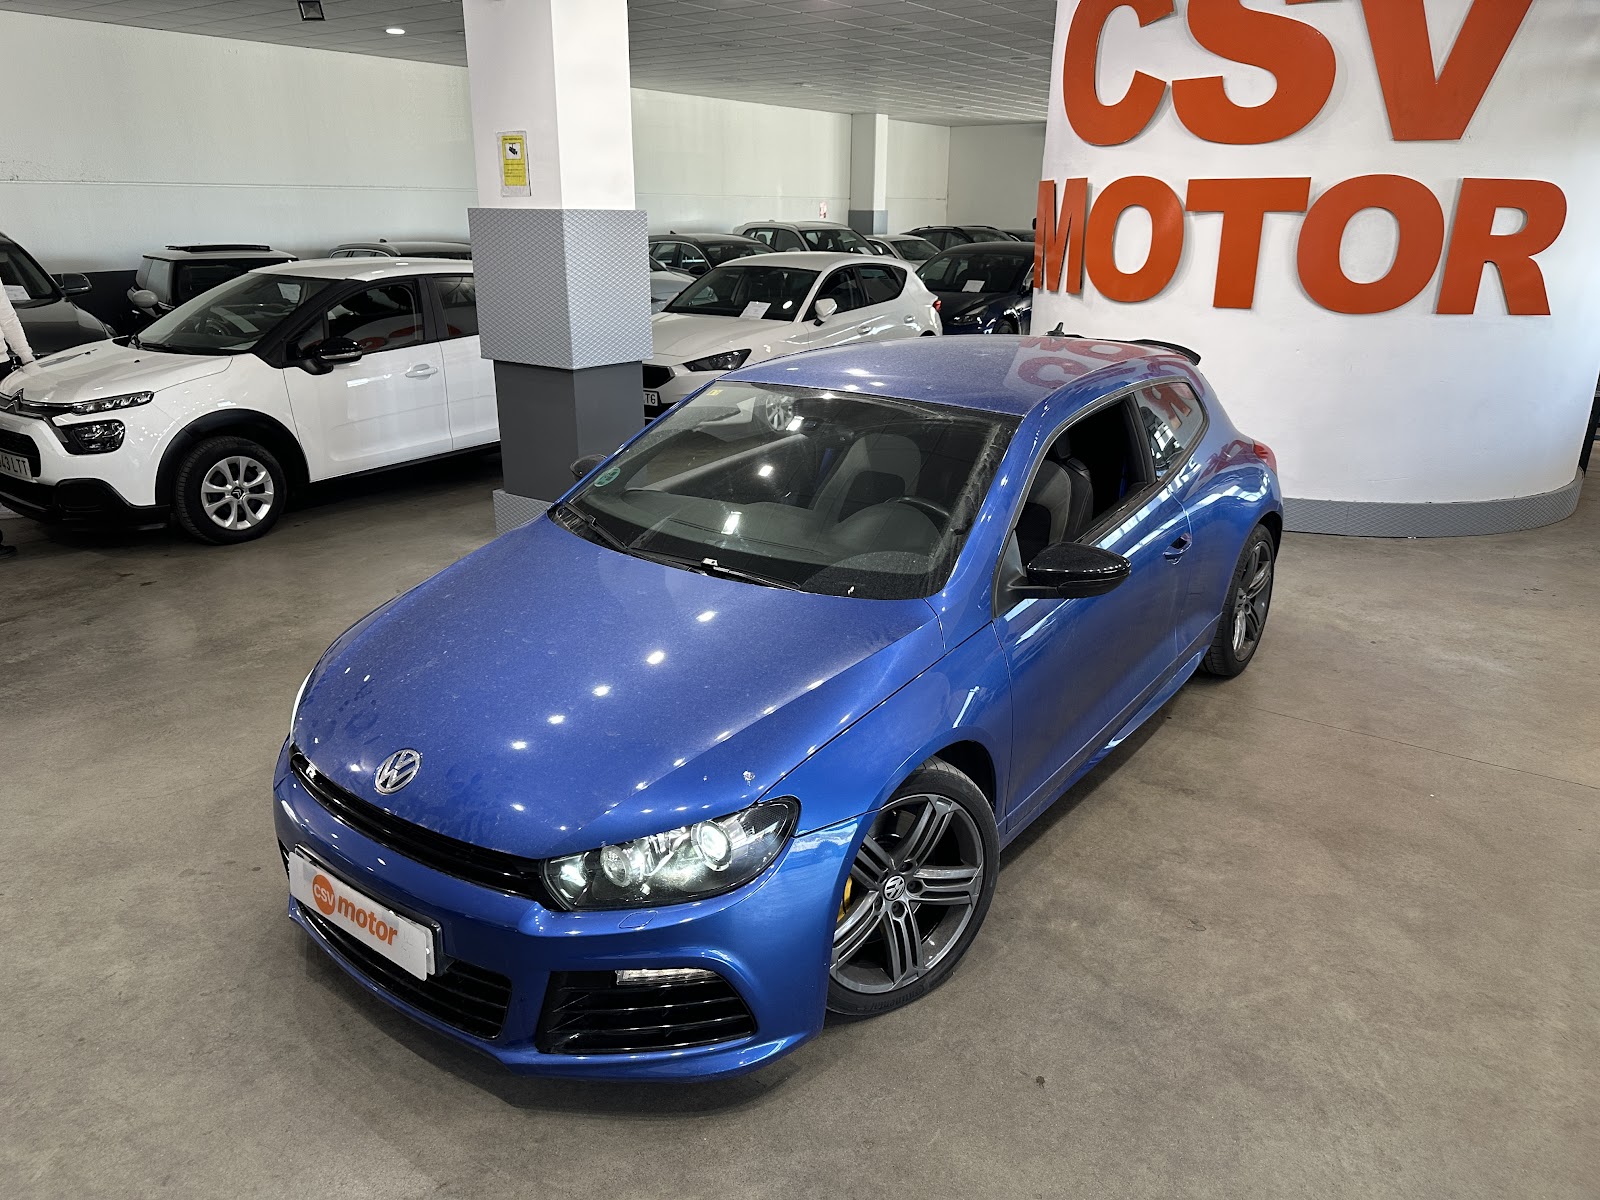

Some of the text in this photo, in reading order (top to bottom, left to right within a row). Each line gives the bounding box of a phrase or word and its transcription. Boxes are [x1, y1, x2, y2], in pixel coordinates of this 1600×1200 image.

[1063, 0, 1535, 146] CSV
[1034, 173, 1568, 315] MOTOR
[338, 895, 398, 946] motor
